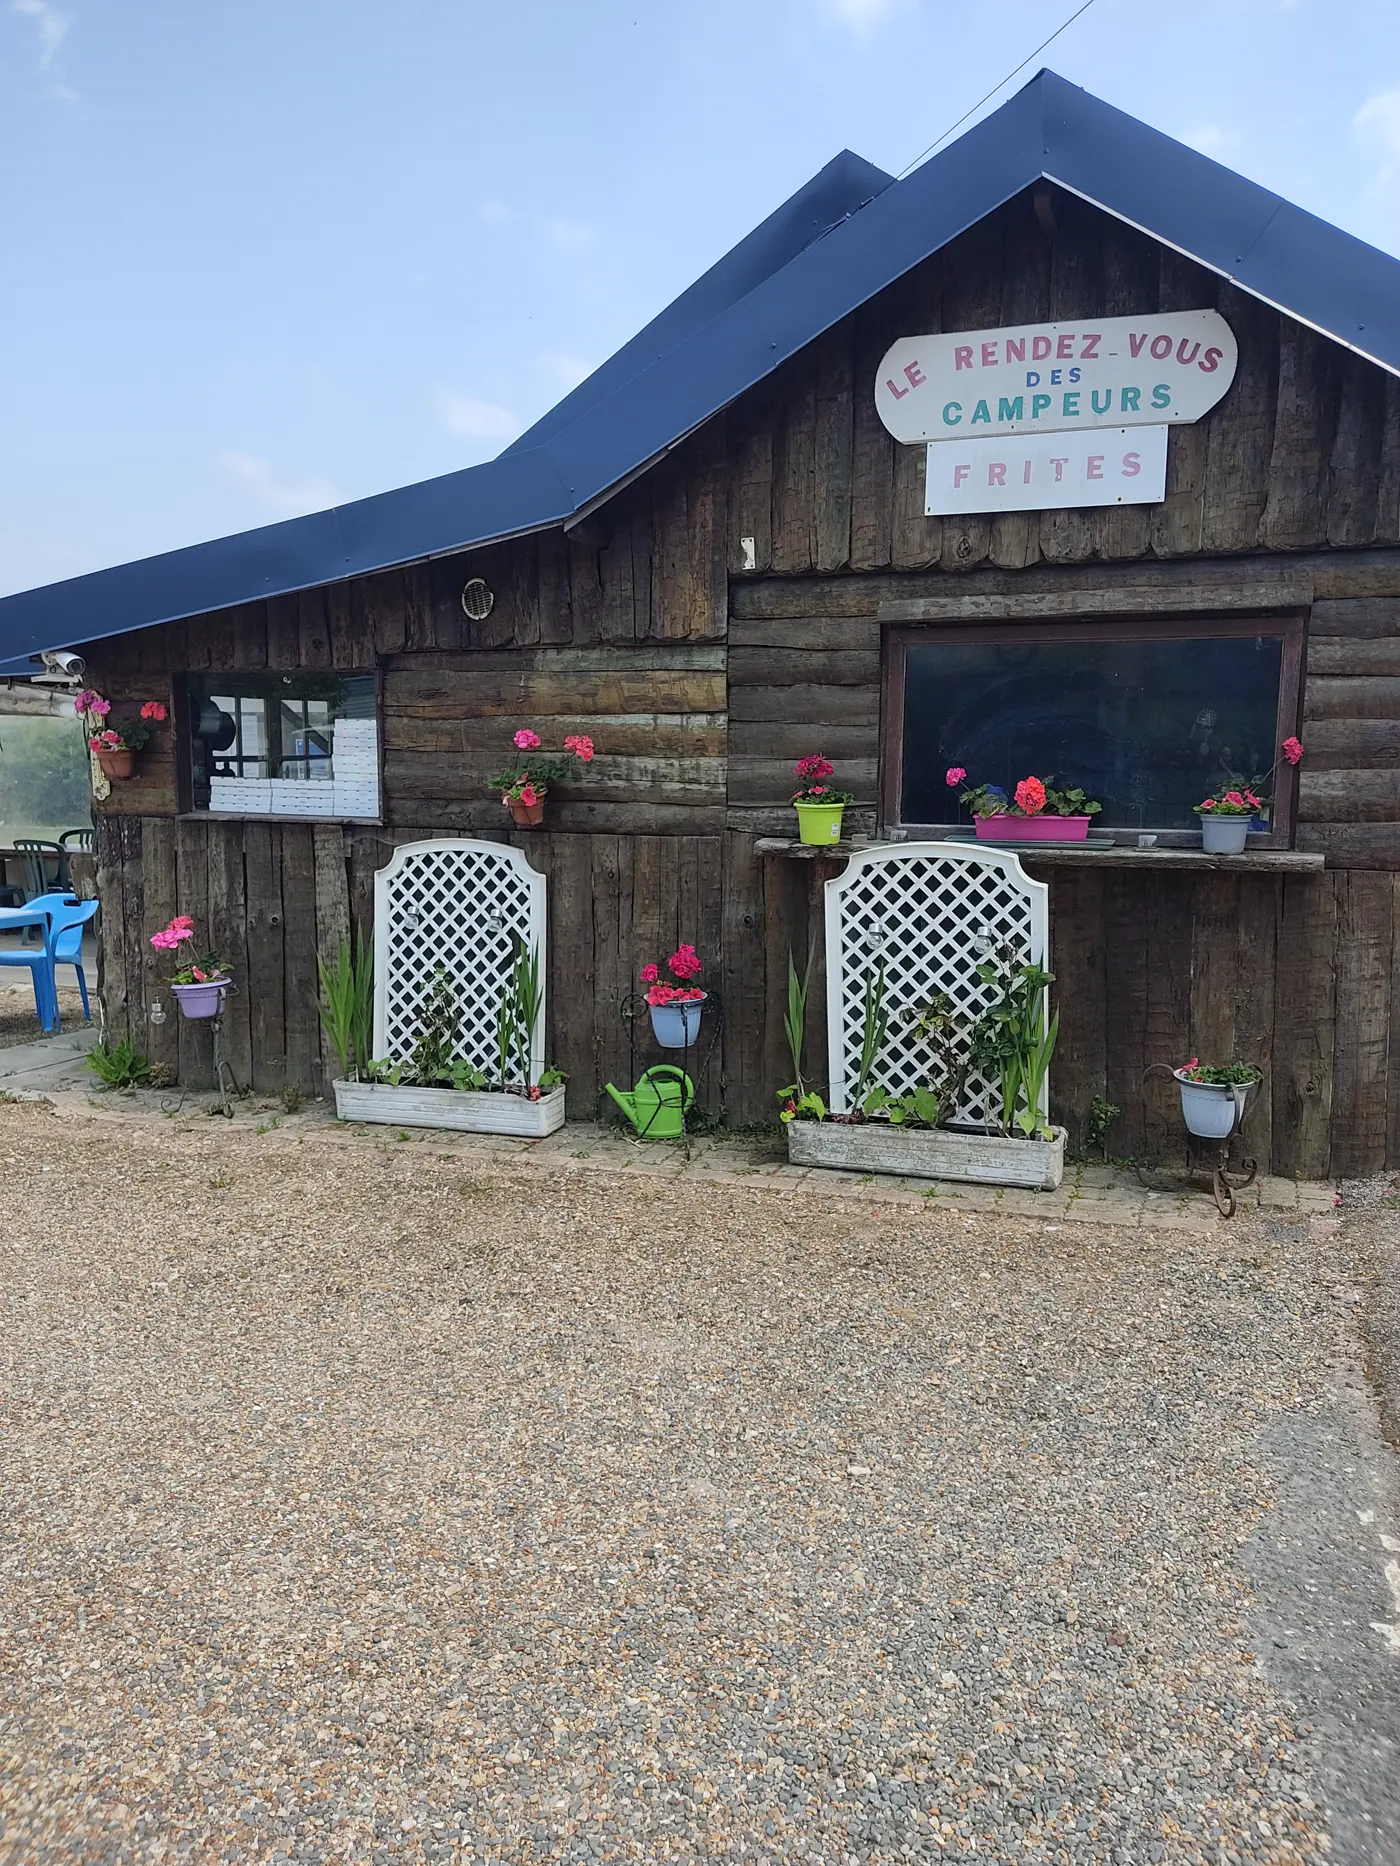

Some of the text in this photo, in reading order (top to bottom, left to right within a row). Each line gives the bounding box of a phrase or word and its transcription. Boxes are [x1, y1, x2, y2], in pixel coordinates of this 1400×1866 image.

[886, 360, 928, 401] LE
[1026, 367, 1081, 388] DES
[942, 383, 1172, 426] CAMPEURS
[953, 452, 1142, 489] FRITES
